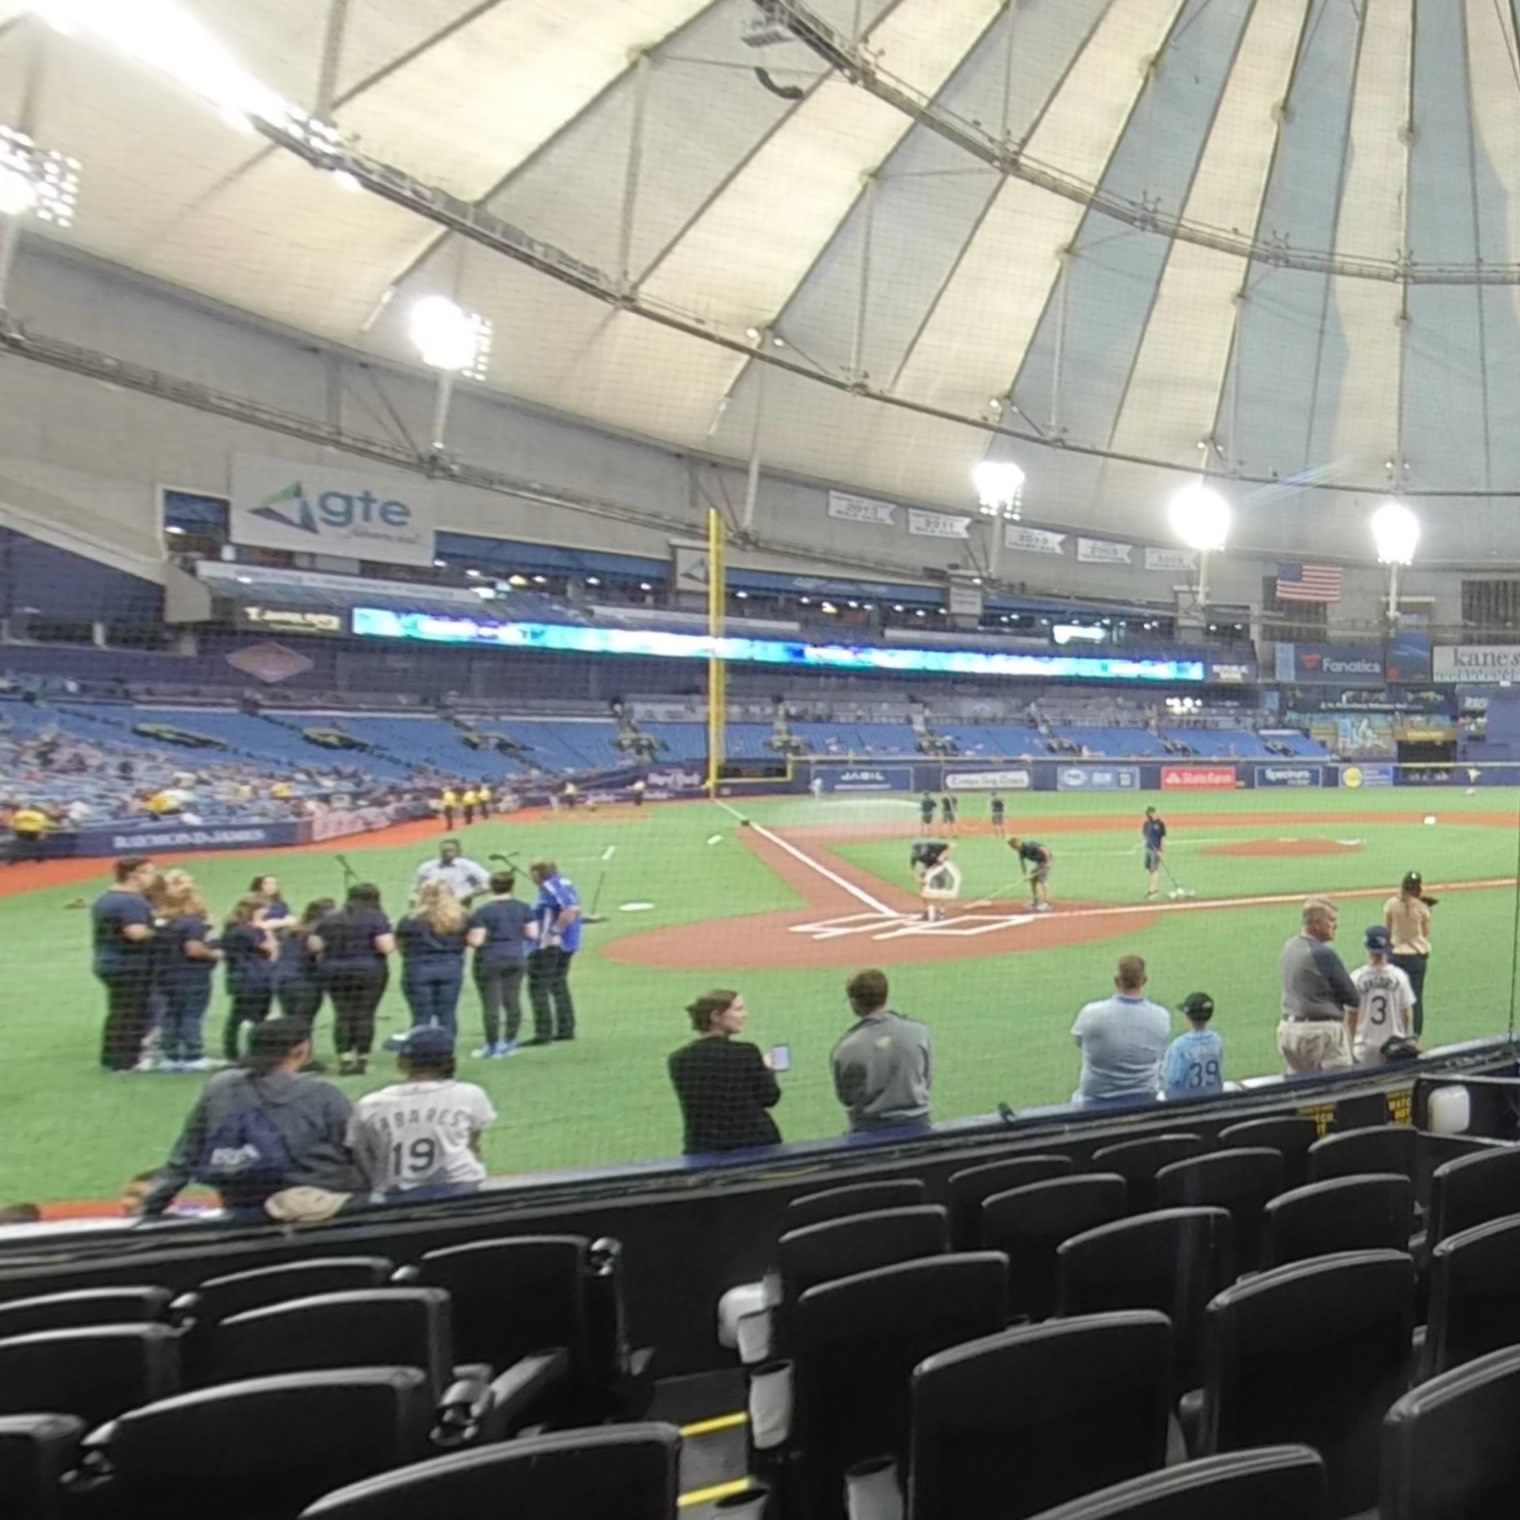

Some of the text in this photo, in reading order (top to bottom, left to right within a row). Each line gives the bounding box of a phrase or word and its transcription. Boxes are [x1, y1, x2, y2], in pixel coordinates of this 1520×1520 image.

[319, 489, 411, 528] gte
[1322, 658, 1382, 674] Fanatics
[1370, 994, 1388, 1026] 3
[1188, 1060, 1220, 1089] 39
[391, 1137, 437, 1177] 19
